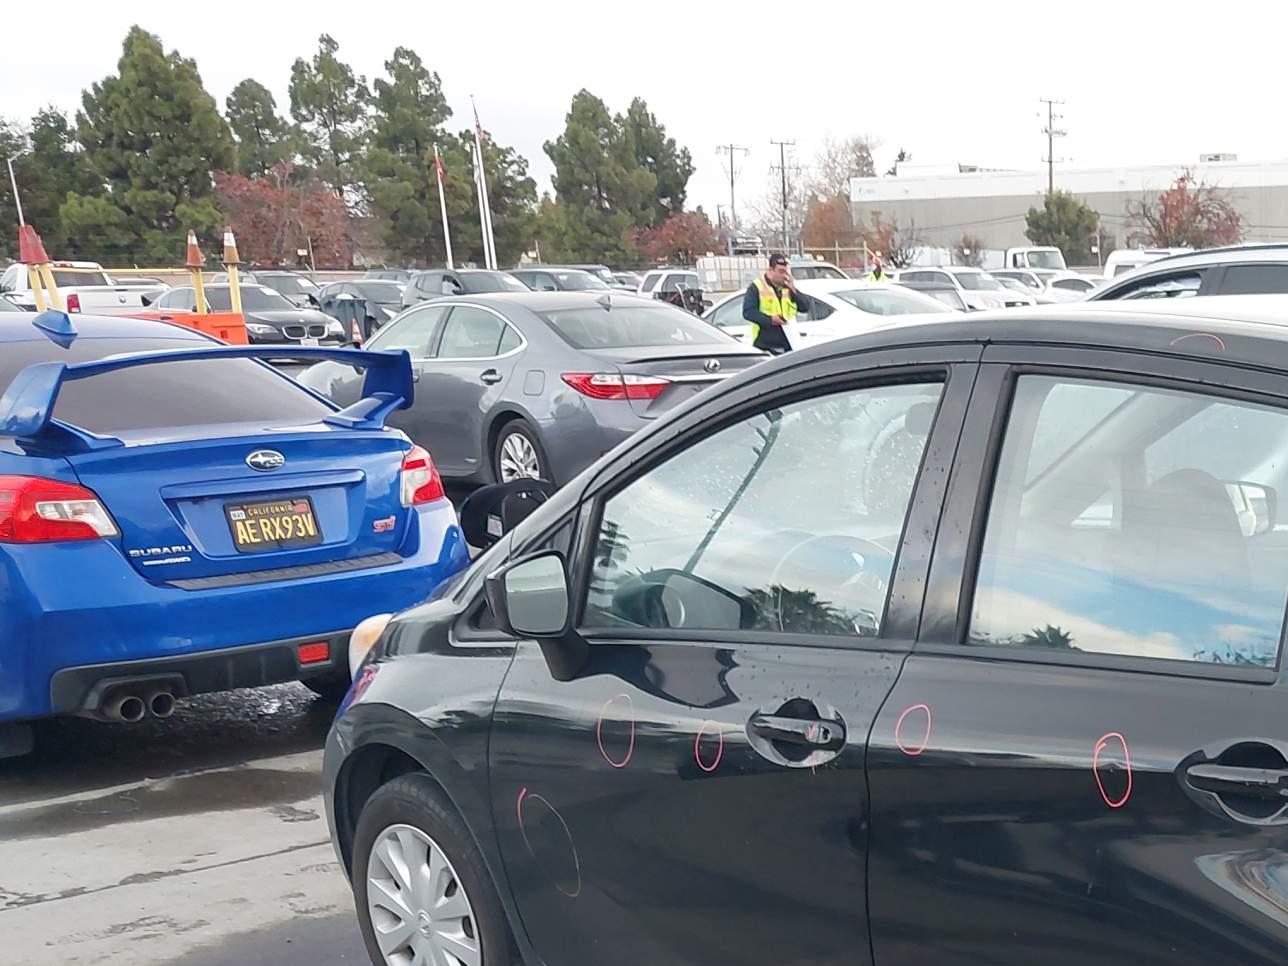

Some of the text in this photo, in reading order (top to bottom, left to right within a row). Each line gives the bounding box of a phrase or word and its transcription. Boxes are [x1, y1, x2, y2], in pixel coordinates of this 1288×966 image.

[247, 504, 293, 516] CALIFORNIA
[258, 513, 315, 542] RX93V
[128, 545, 192, 557] SUBARU
